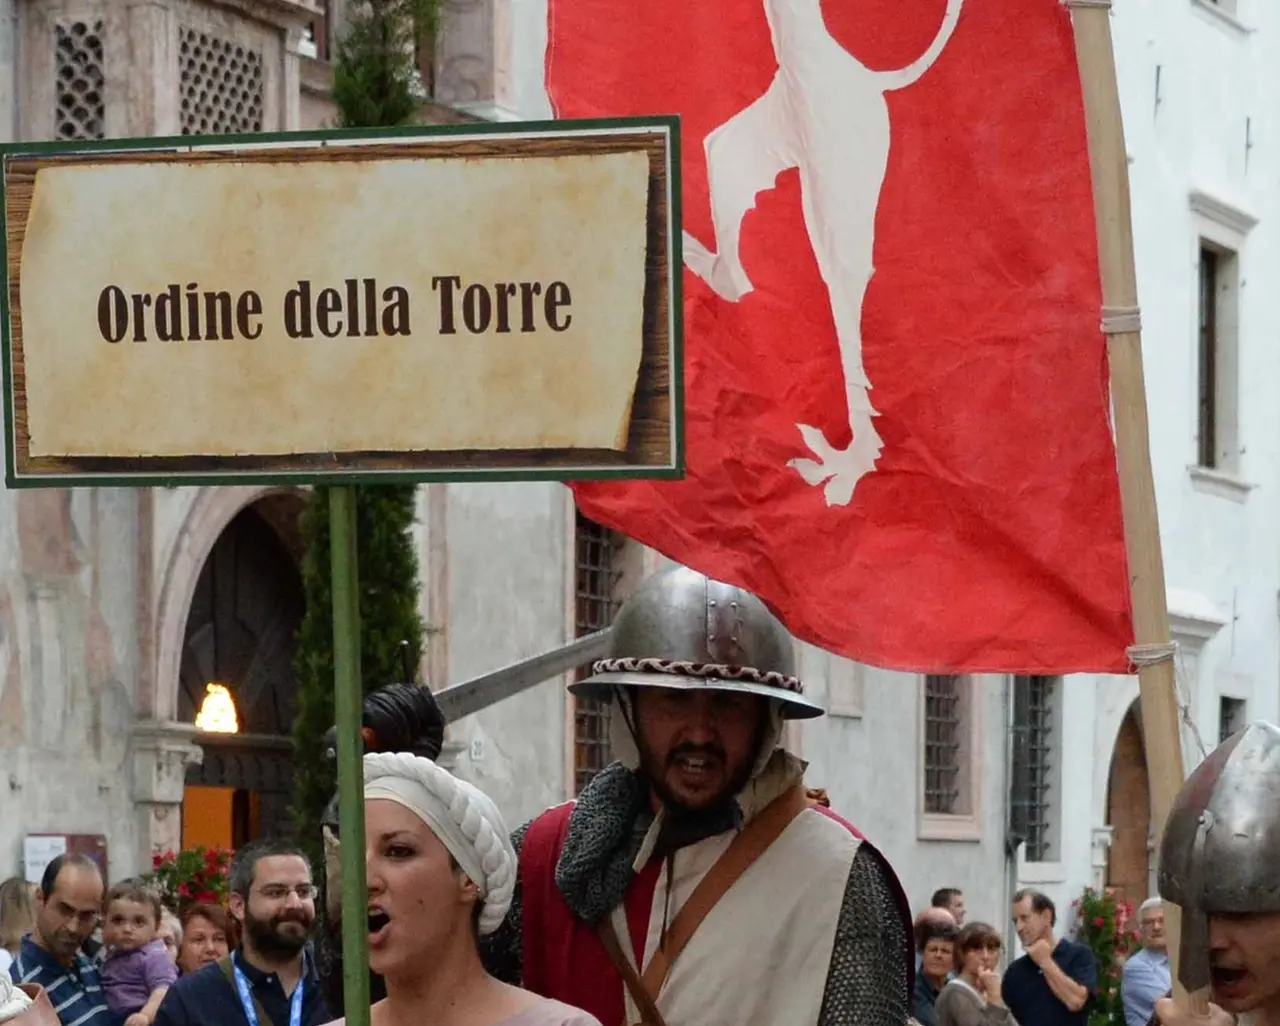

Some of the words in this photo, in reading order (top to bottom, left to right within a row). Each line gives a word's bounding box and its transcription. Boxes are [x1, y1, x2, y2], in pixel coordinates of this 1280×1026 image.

[97, 283, 264, 343] Ordine
[283, 279, 412, 340] della
[431, 275, 573, 335] Torre
